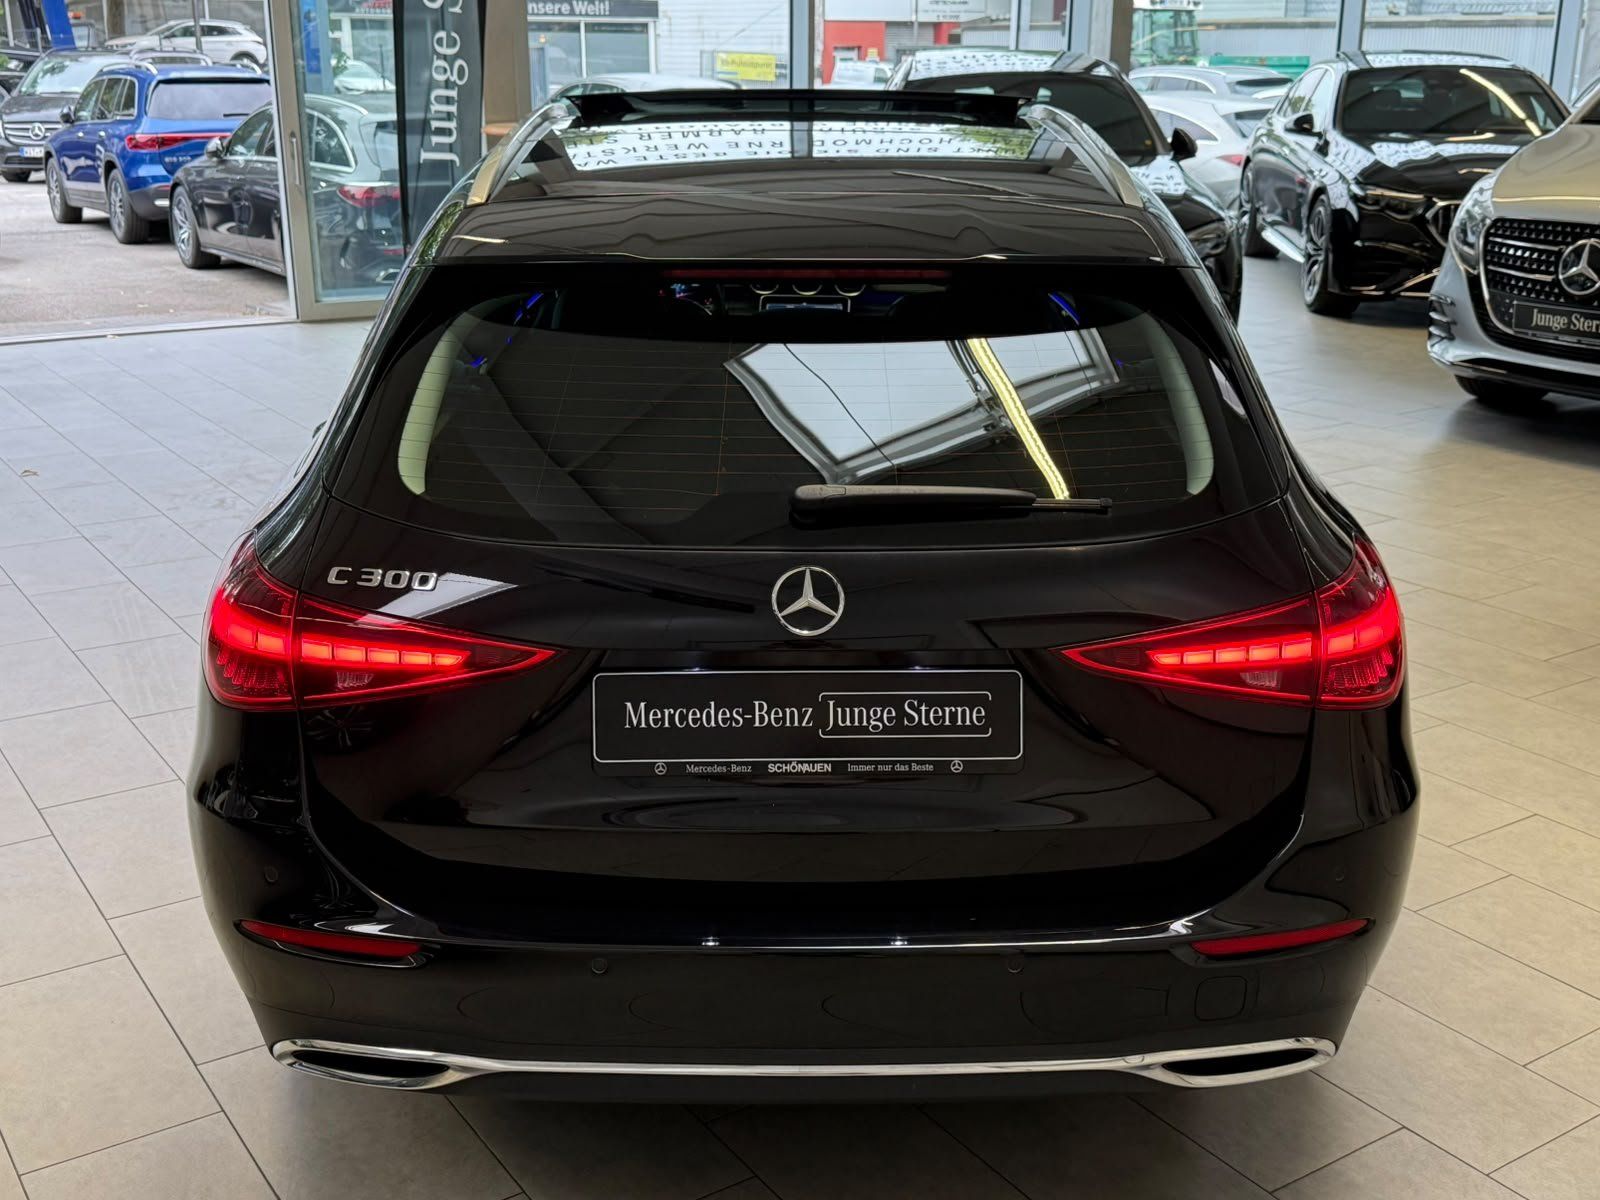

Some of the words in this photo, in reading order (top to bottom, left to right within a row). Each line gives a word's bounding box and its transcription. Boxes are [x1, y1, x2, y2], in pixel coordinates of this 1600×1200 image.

[572, 1, 609, 16] Welt!
[420, 30, 469, 167] Junge
[1531, 308, 1568, 331] Junge
[1570, 312, 1600, 333] Ster
[327, 566, 352, 585] C
[356, 568, 438, 591] 300
[624, 699, 814, 729] Mercedes-Benz
[825, 698, 896, 733] Junge
[903, 698, 986, 728] Sterne
[686, 763, 753, 774] Mercedes-Benz
[767, 761, 832, 774] SCHÖNAUEN
[847, 762, 876, 772] Immer
[877, 763, 893, 772] nur
[894, 762, 909, 772] das
[911, 762, 934, 772] Beste
